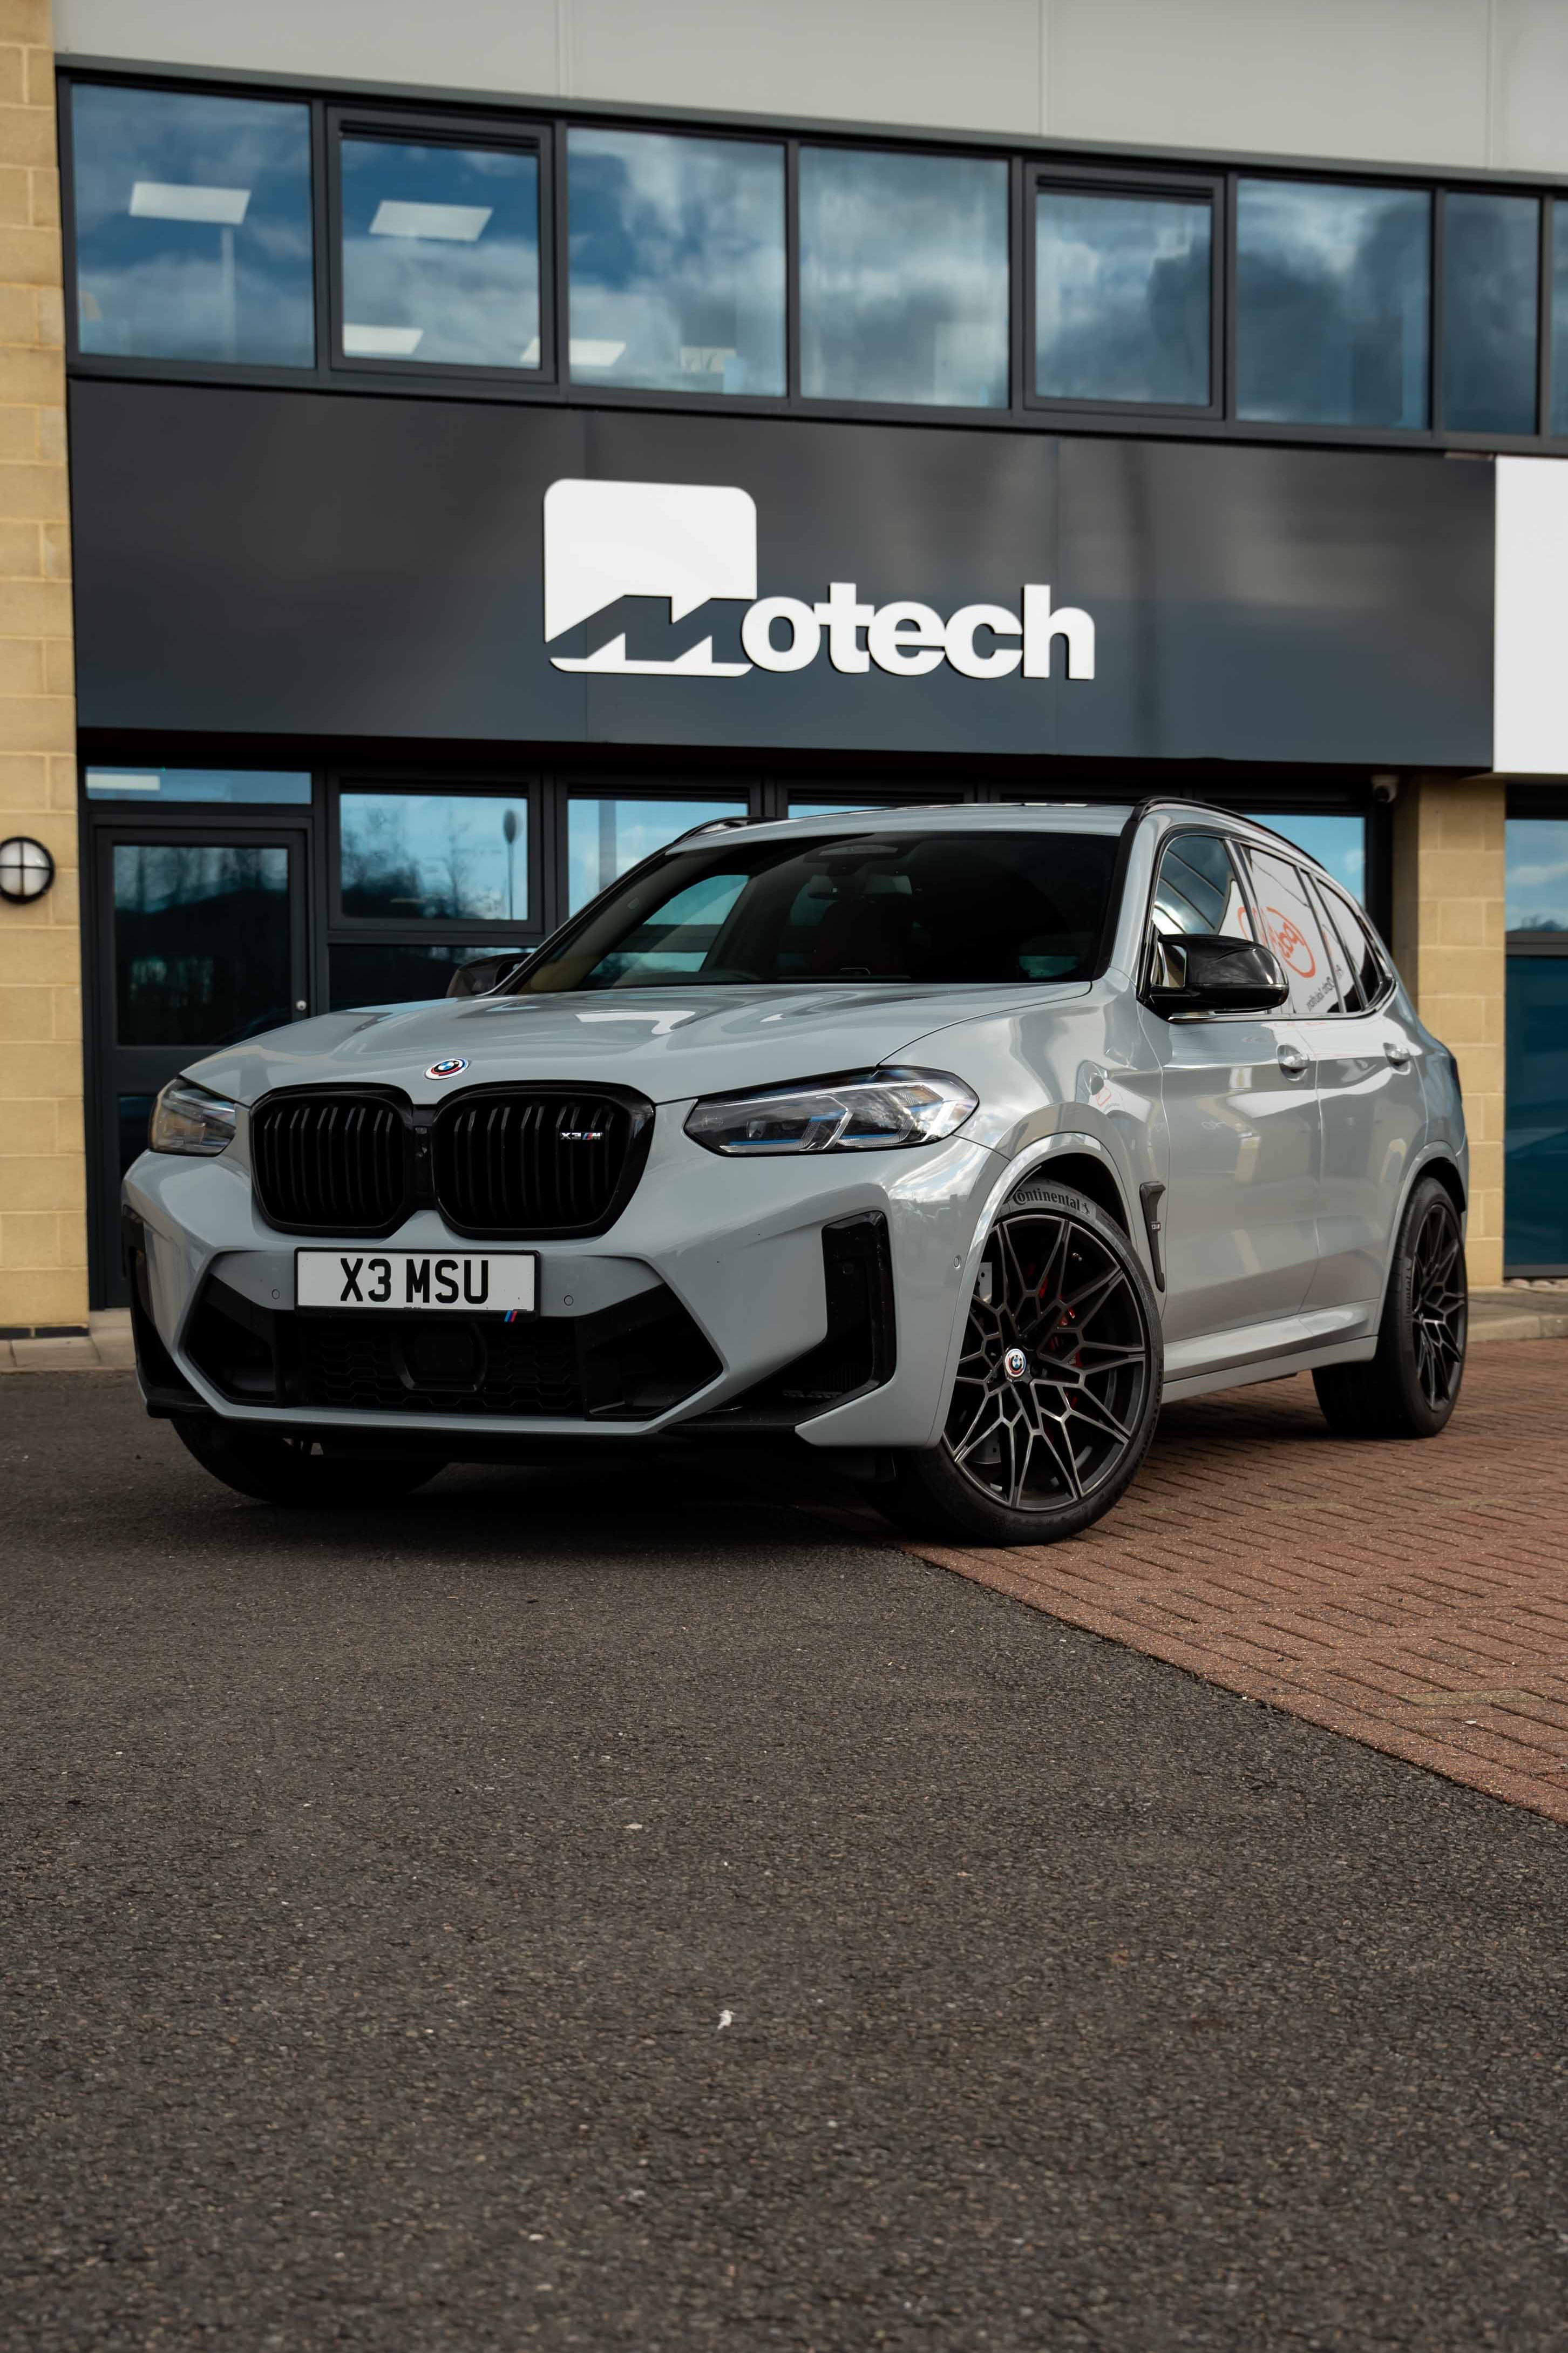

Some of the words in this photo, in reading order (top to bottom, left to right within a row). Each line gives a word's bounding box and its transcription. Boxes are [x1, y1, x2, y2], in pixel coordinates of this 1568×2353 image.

[1012, 1188, 1081, 1212] Continental
[340, 1257, 391, 1302] X3
[406, 1259, 489, 1304] MSU
